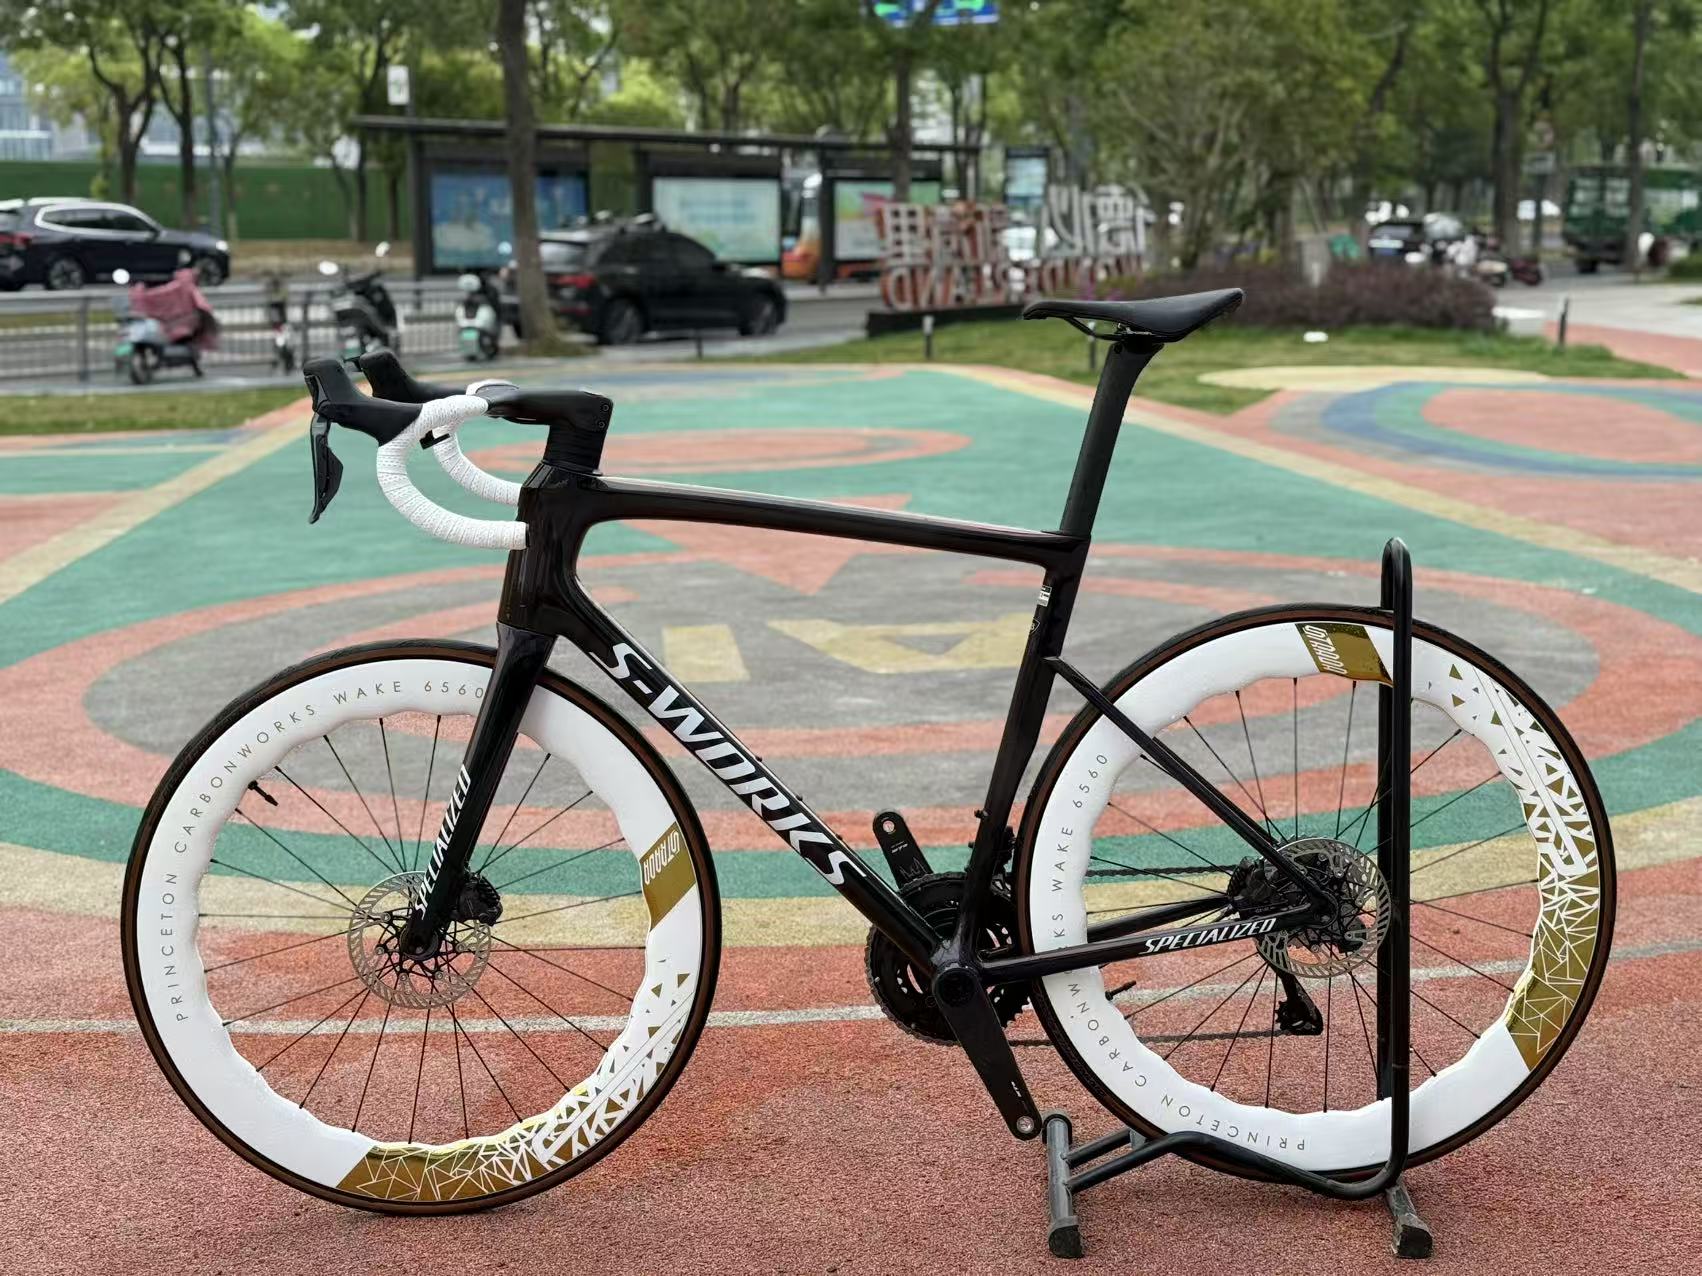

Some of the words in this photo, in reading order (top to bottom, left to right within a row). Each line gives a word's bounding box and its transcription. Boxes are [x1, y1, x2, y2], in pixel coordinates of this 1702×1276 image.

[1302, 625, 1348, 675] STRADA
[333, 681, 401, 705] WAKE
[424, 680, 484, 699] 6560
[174, 704, 315, 853] CARBONWORKS
[589, 642, 867, 885] S-WORKS
[1072, 754, 1108, 809] 6560
[415, 763, 471, 920] SPECIALIZED
[643, 829, 680, 886] STRADA
[1051, 826, 1074, 892] WAKE
[160, 873, 189, 1022] PRINCETON
[1138, 917, 1277, 955] SPECIALIZED
[1052, 913, 1147, 1087] CARBONWKS
[1161, 1094, 1305, 1150] PRINCETON
